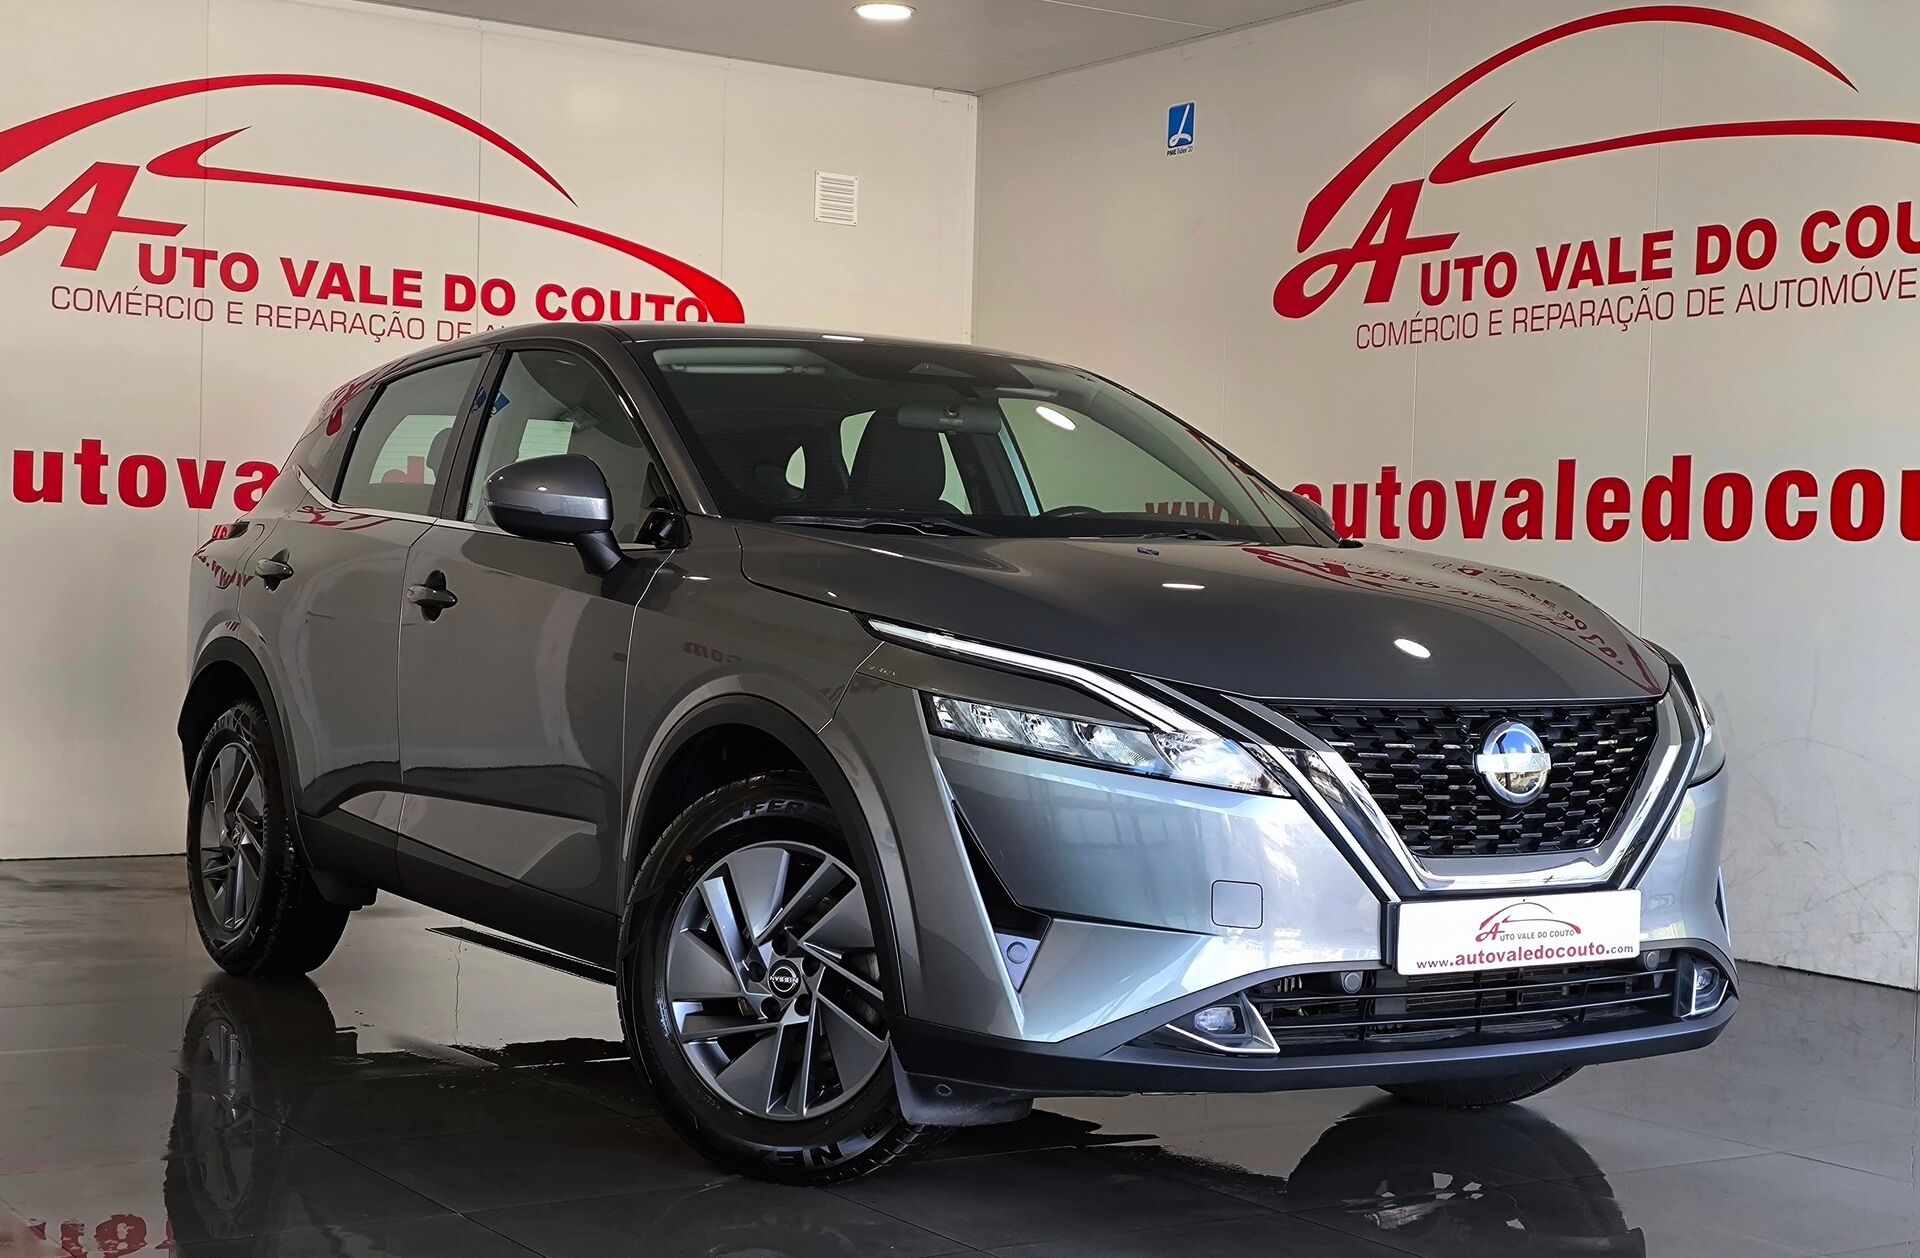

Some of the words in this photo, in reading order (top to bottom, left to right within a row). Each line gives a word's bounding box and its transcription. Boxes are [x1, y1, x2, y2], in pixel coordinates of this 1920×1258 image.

[1536, 230, 1676, 295] VALE
[1695, 218, 1779, 277] DO
[51, 284, 214, 323] COMÉRCIO
[226, 300, 244, 325] E
[255, 303, 426, 344] REPARAÇÃO
[280, 256, 424, 311] VALE
[444, 273, 517, 319] DO
[534, 283, 710, 324] COUTO
[1356, 311, 1479, 350] COMÉRCIO
[1488, 308, 1503, 337] E
[1512, 286, 1675, 334] REPARAÇÃO
[1686, 286, 1726, 318] DE
[1734, 265, 1919, 314] AUTOMÓVE
[1416, 942, 1634, 970] www.autovaledocouto.com
[1516, 931, 1536, 941] VALE
[1537, 930, 1548, 939] DO
[1549, 929, 1575, 939] COUTO
[769, 975, 799, 984] NISSAN
